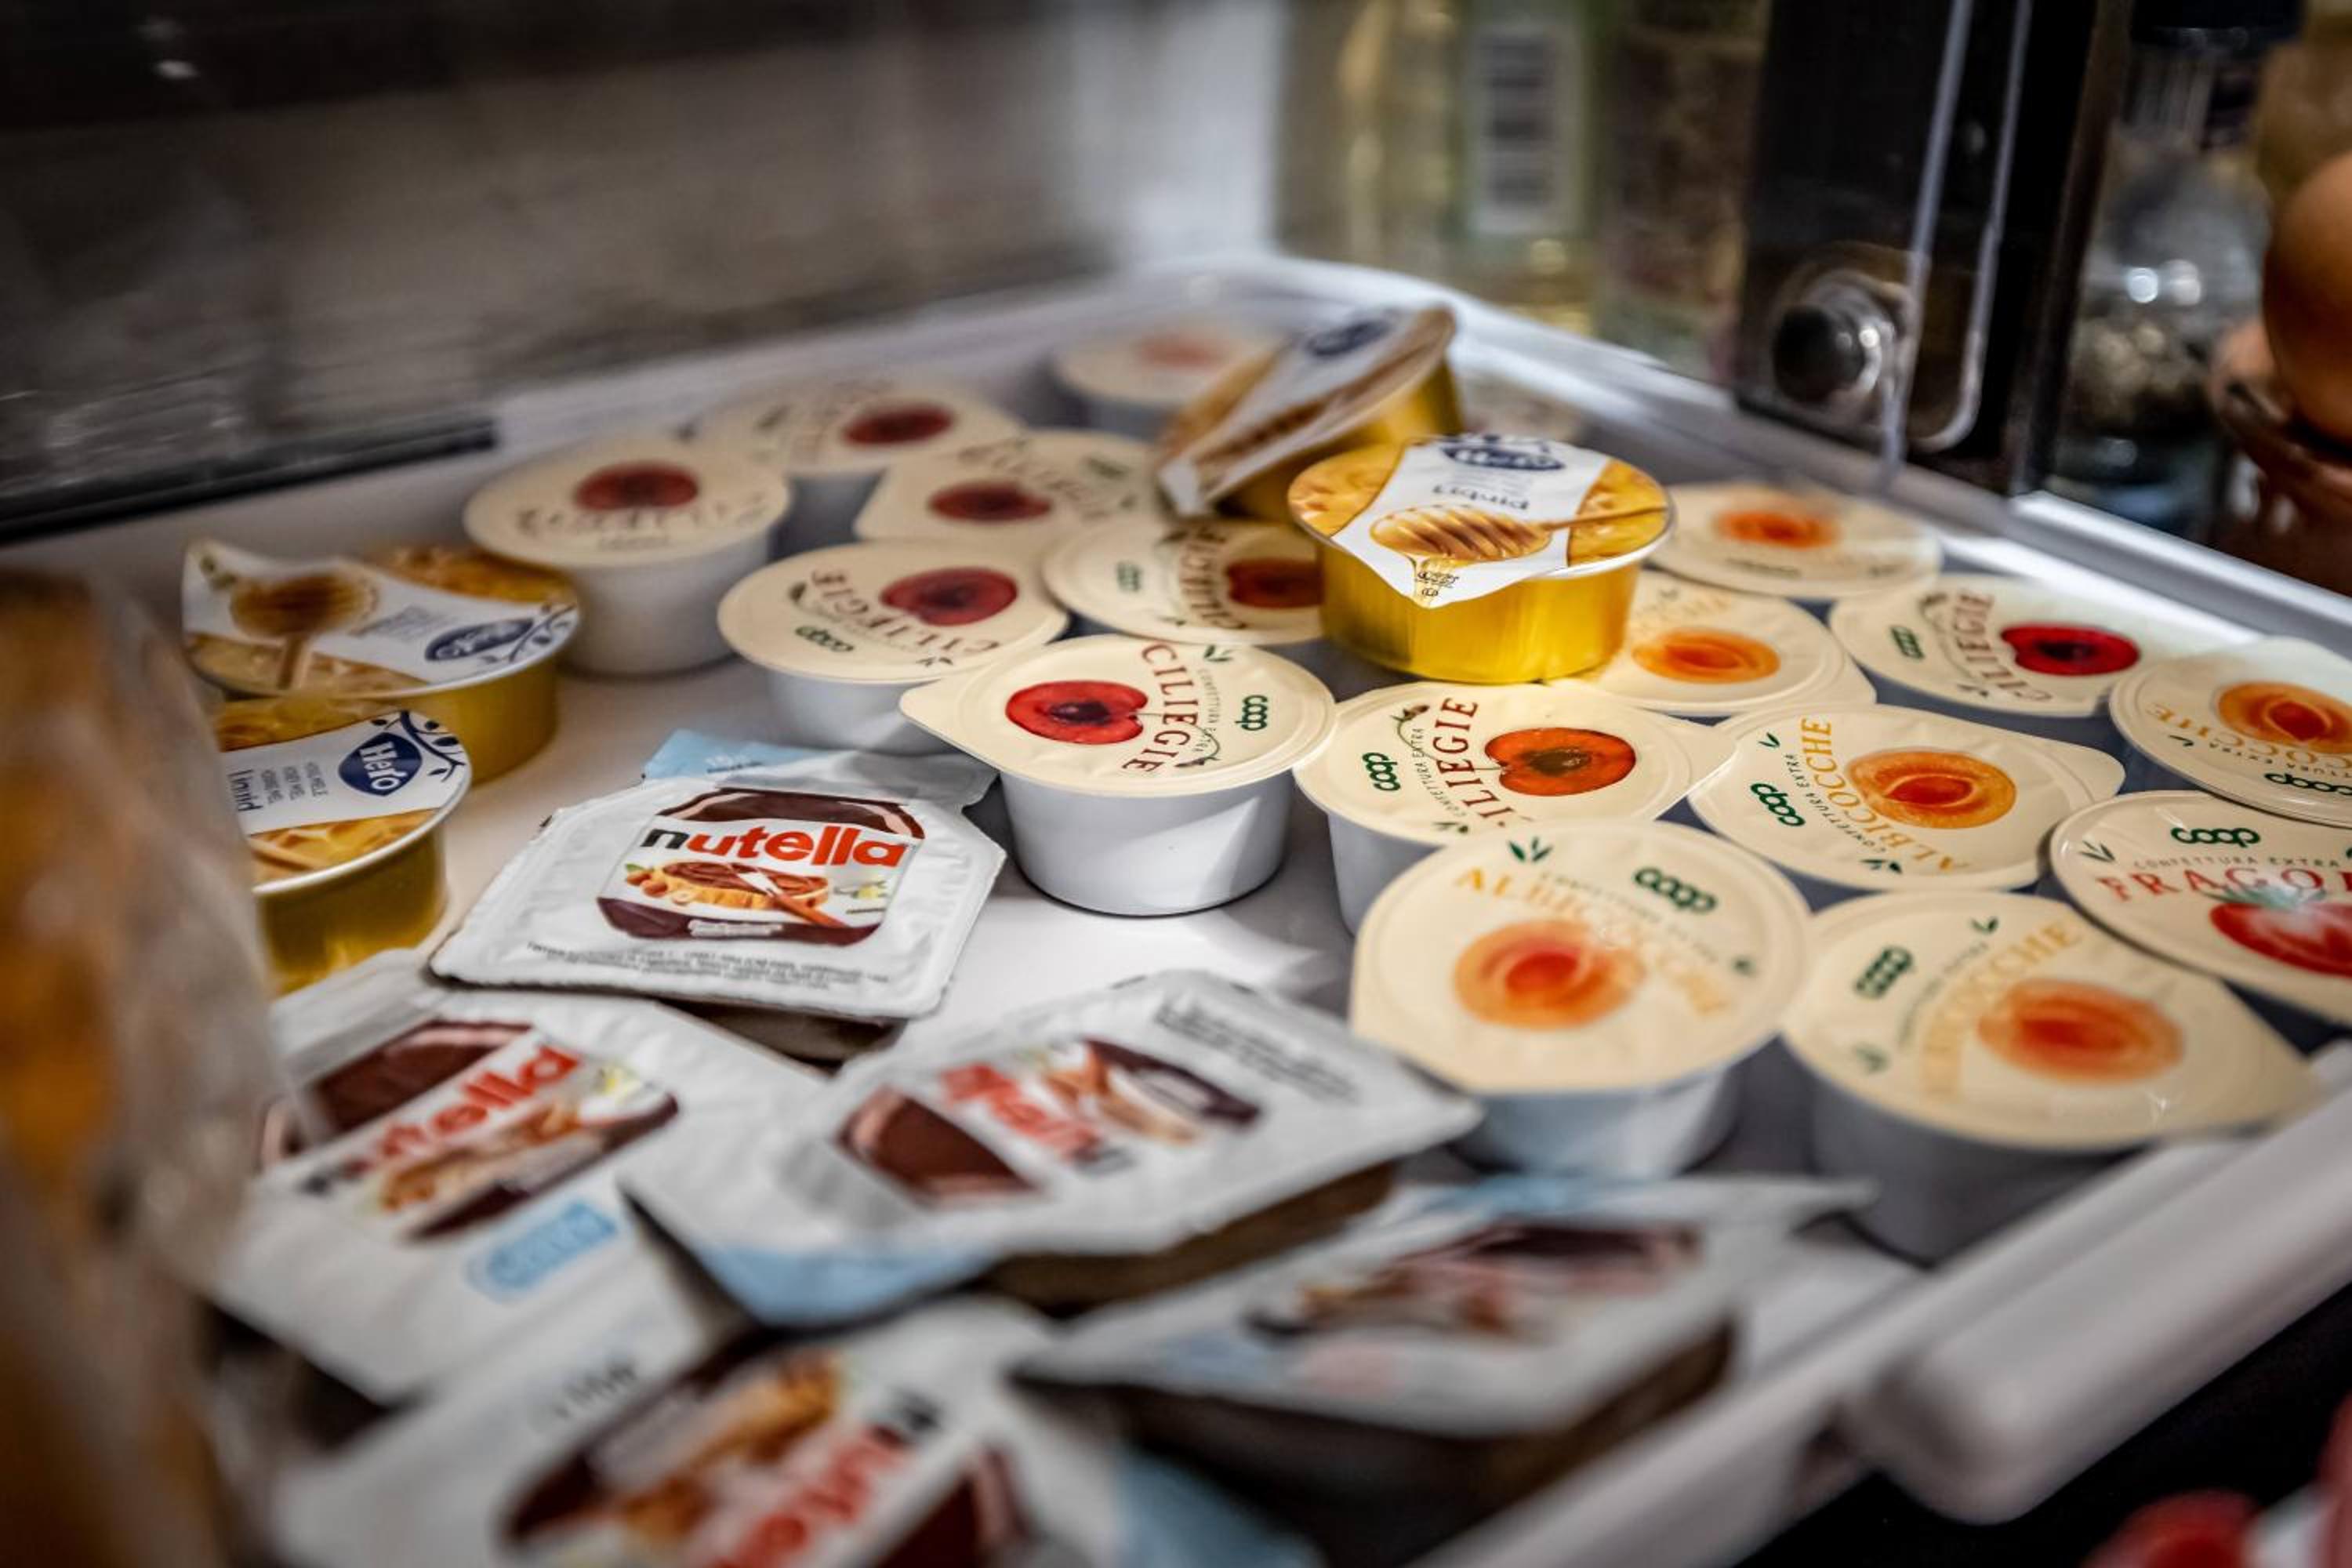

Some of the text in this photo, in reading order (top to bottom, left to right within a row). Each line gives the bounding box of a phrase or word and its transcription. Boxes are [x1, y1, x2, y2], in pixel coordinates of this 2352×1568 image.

[811, 568, 999, 656] CILIEGIE
[1955, 588, 2053, 702] CILIEGIE
[1121, 640, 1200, 773] CILIEGIE
[1234, 694, 1269, 731] coop
[358, 742, 408, 792] Hero
[1361, 751, 1402, 792] coop
[1432, 696, 1534, 827] ILIEGIE
[1750, 782, 1806, 828] coop
[1784, 752, 1888, 854] CONFETTURA EXTRA
[1800, 717, 1971, 873] ALBICOCCHE
[639, 823, 909, 868] nutella
[2170, 826, 2262, 848] coop
[1633, 866, 1719, 915] coop
